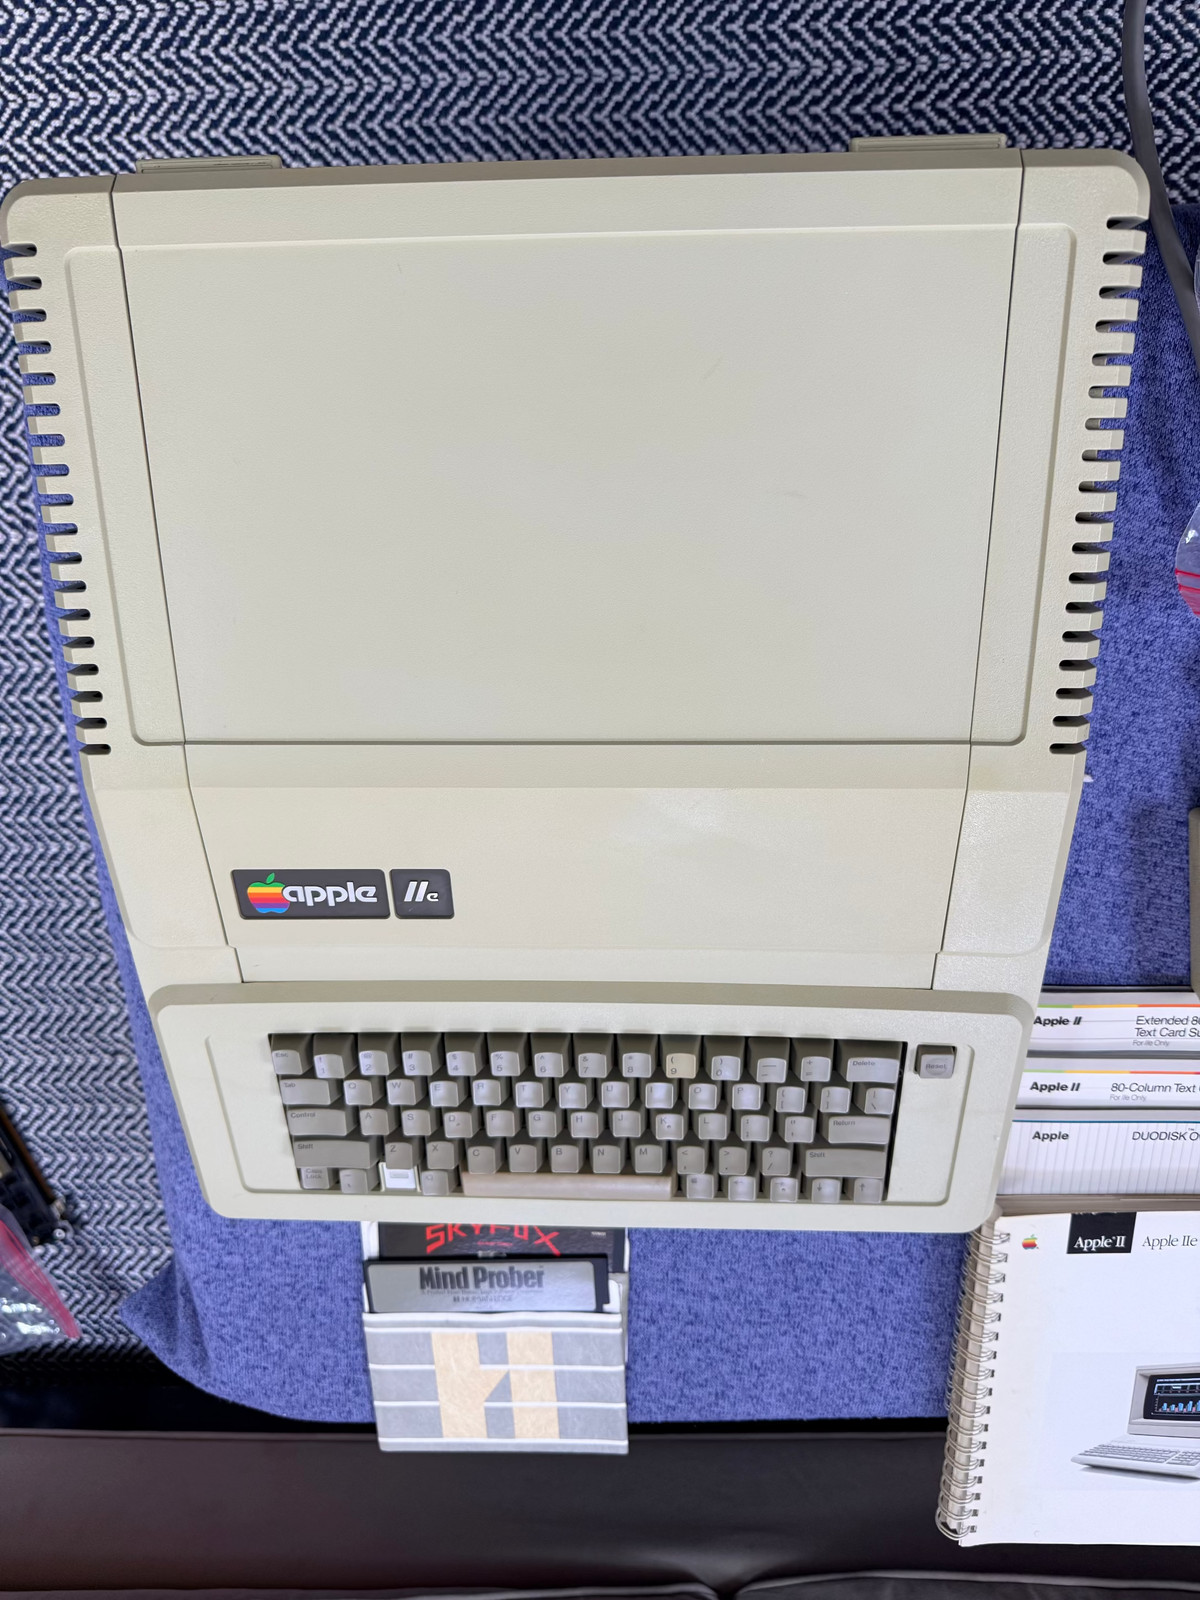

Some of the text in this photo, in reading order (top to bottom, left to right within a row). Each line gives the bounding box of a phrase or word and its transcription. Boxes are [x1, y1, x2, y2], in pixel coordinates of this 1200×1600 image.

[282, 881, 378, 907] apple
[1033, 1016, 1070, 1026] Apple
[1136, 1016, 1189, 1025] Extended
[1135, 1028, 1156, 1037] Text
[1159, 1027, 1186, 1037] Card
[1030, 1081, 1081, 1093] Apple II
[1111, 1083, 1196, 1093] 80-Column Text
[1032, 1131, 1069, 1142] Apple
[1132, 1131, 1186, 1141] DUODISK
[1142, 1235, 1198, 1250] Apple IIe
[420, 1266, 544, 1289] Mind Prober
